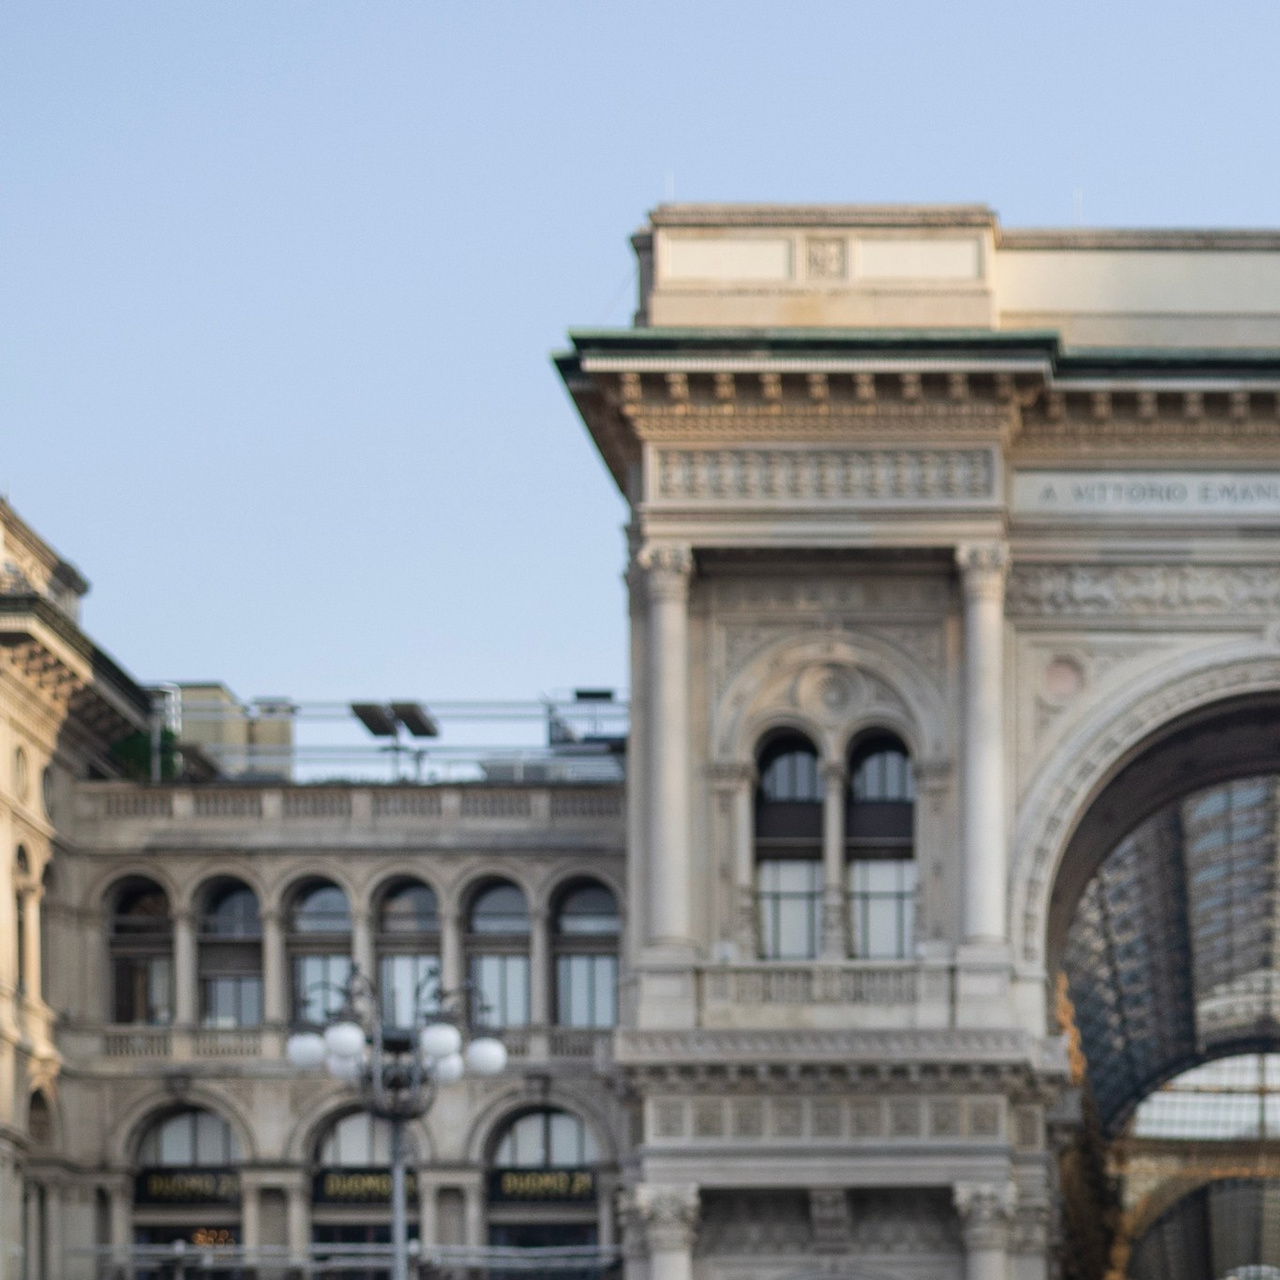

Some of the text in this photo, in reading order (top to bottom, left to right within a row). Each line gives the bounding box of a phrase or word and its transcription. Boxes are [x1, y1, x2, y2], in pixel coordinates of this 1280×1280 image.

[1039, 481, 1056, 502] A
[1070, 481, 1188, 503] VITTORIO
[148, 1174, 216, 1195] DUOMO
[501, 1172, 569, 1194] DUOMO
